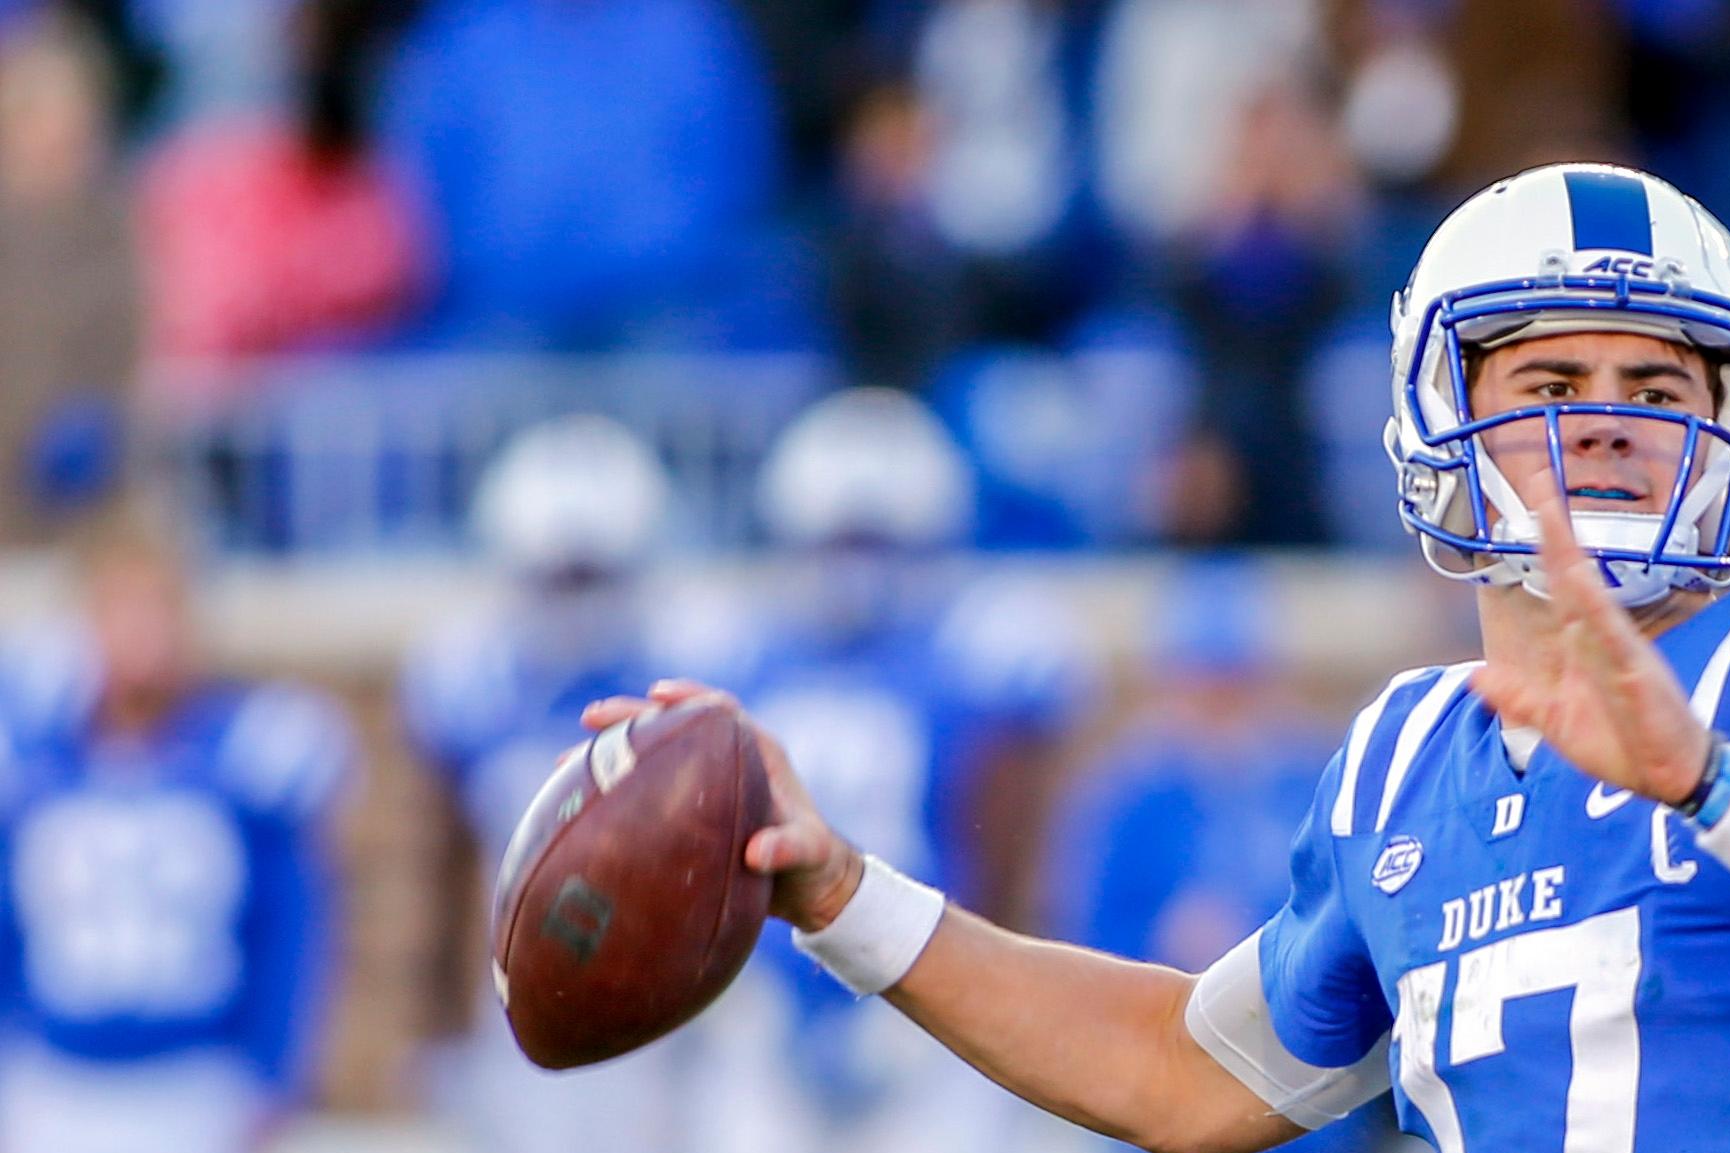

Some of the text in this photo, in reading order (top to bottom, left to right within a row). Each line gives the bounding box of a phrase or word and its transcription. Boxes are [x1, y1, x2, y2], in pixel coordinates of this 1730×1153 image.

[1582, 255, 1654, 278] ACC
[1491, 793, 1525, 837] D
[1379, 848, 1417, 876] ACC
[1437, 864, 1565, 953] DUKE
